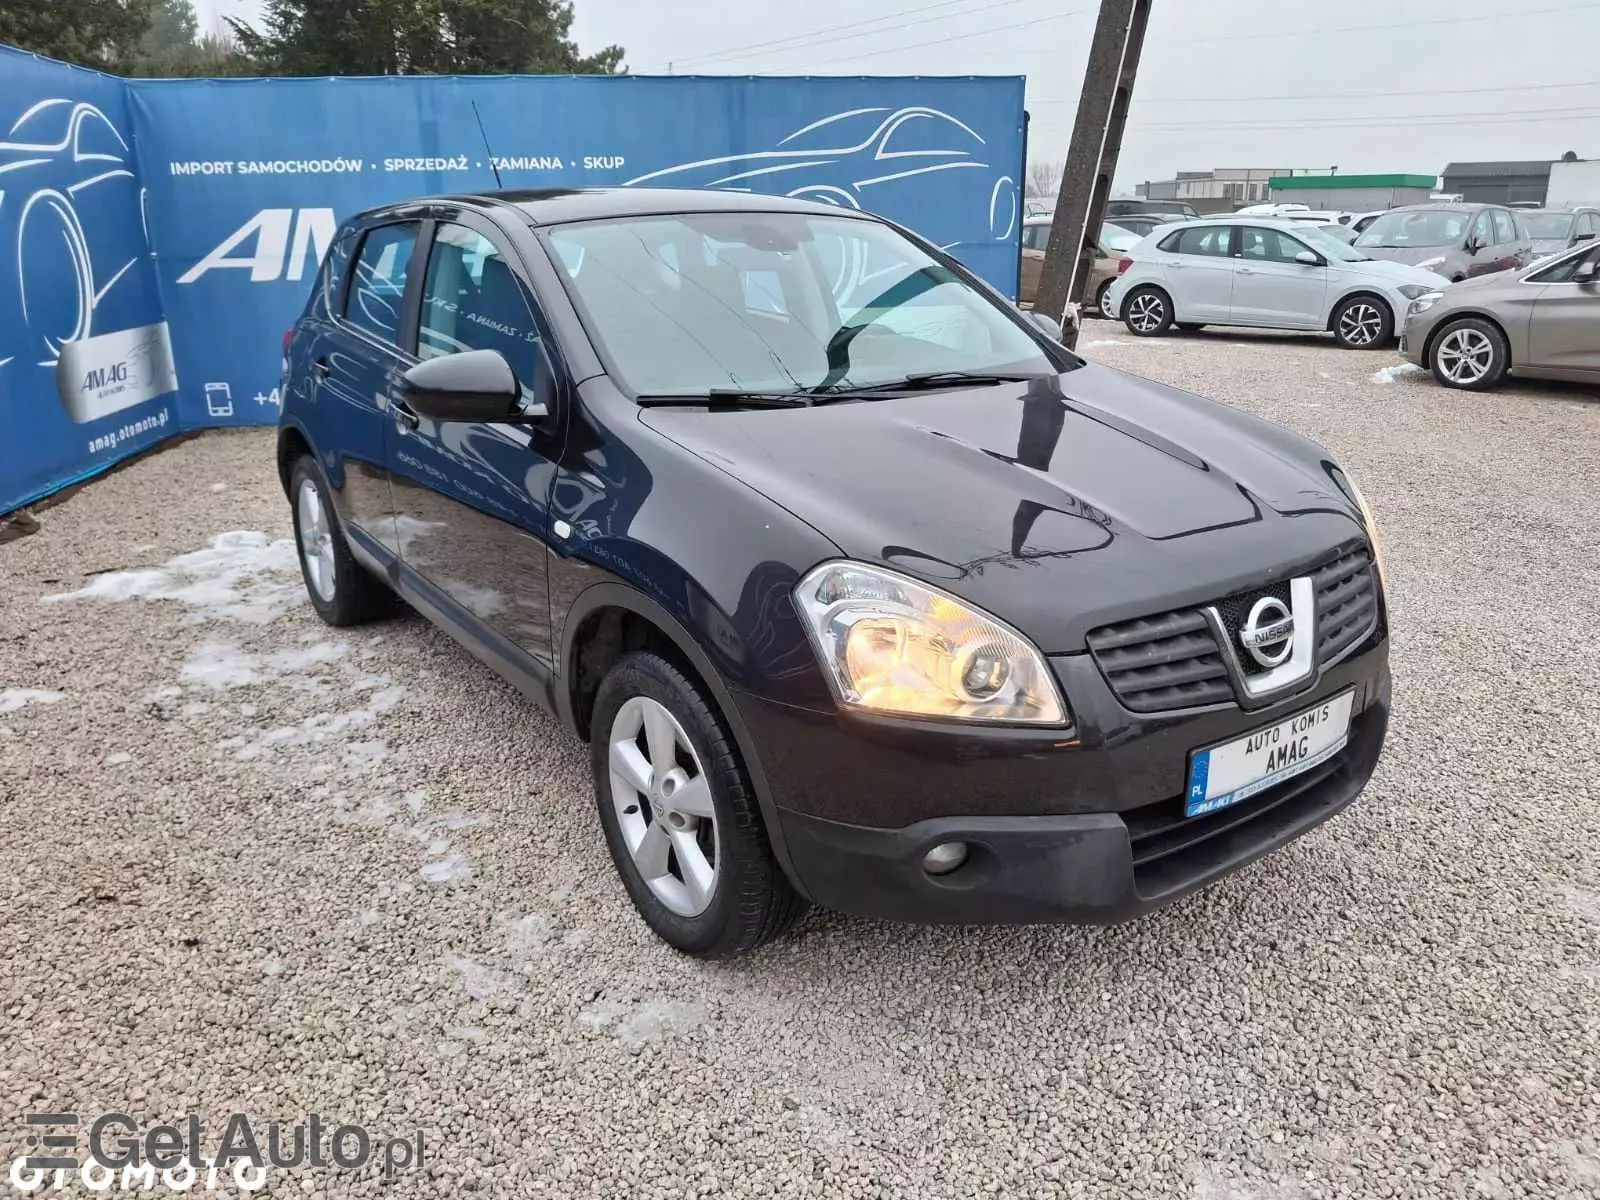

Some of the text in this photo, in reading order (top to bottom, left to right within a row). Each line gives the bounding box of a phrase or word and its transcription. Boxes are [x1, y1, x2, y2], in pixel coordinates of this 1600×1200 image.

[170, 154, 625, 176] IMPORT SAMOCHODÓW SPRZEDAŻ ZAMIANA SKUP
[88, 407, 169, 454] amag.otomoto.pl
[1246, 706, 1330, 755] AUTO KOMIS
[1265, 735, 1309, 774] AMAG
[1192, 785, 1203, 798] PL
